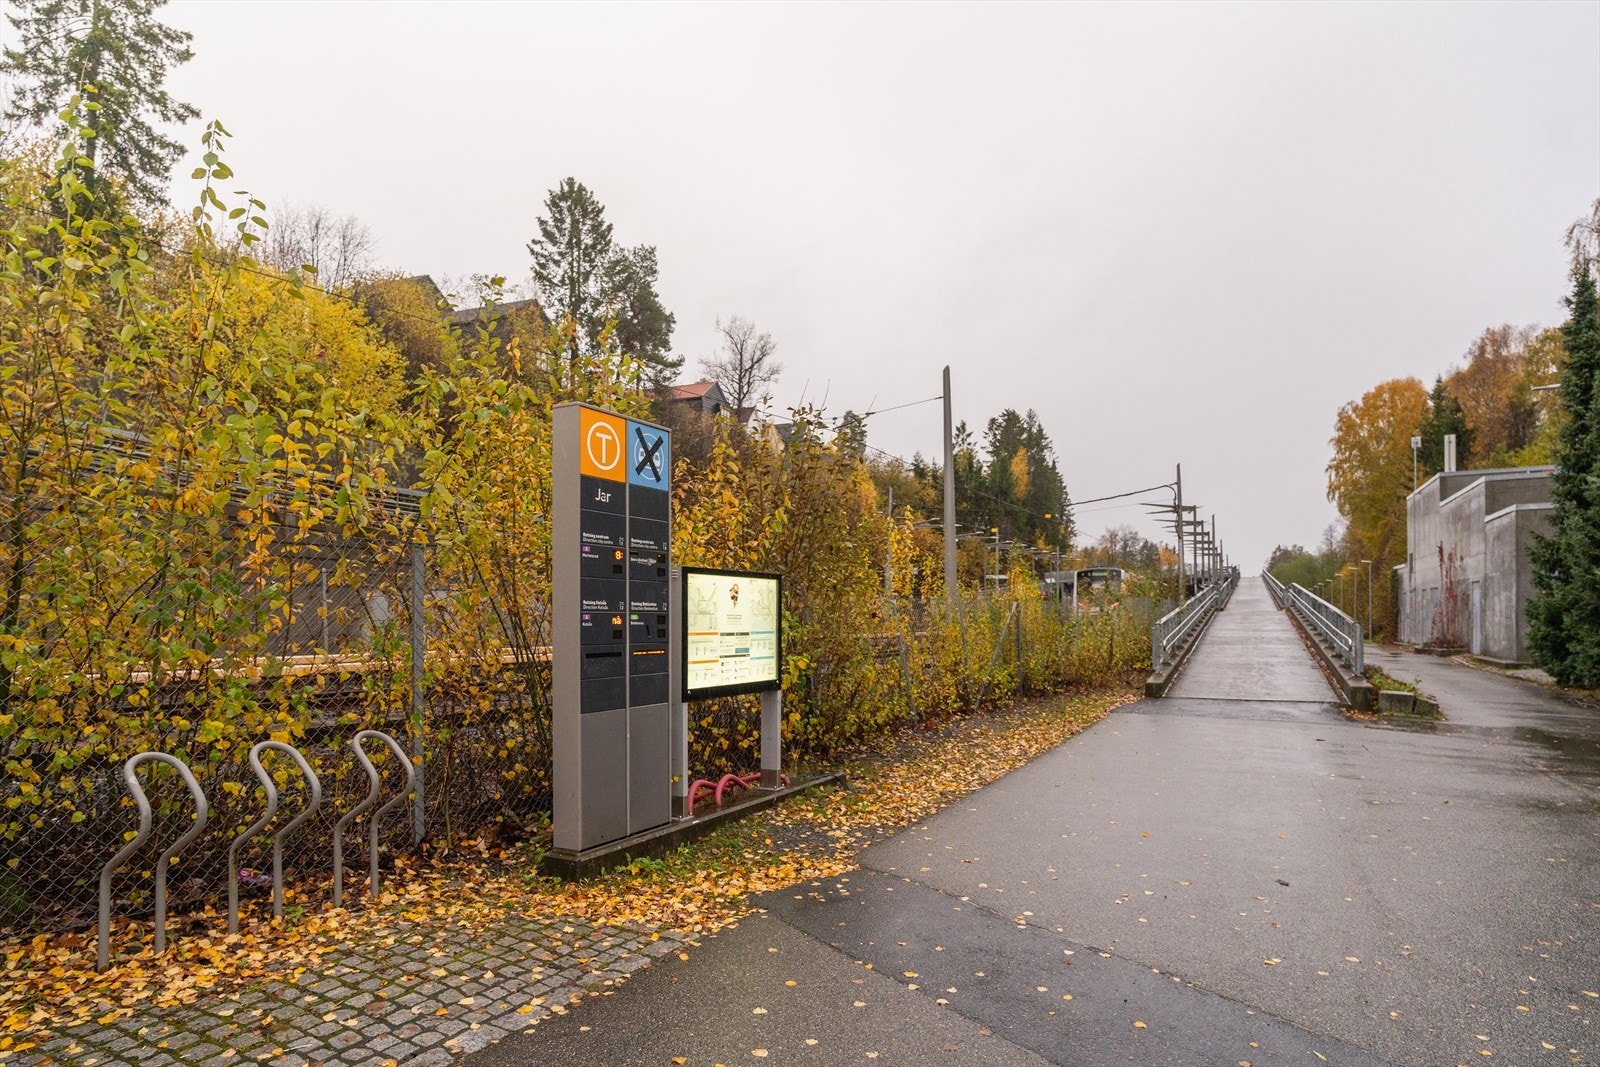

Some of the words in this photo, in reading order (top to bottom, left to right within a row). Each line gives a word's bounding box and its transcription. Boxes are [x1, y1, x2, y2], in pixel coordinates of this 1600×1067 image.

[596, 432, 612, 463] T
[595, 488, 611, 502] Jar
[615, 550, 621, 560] 8
[612, 615, 622, 625] nå
